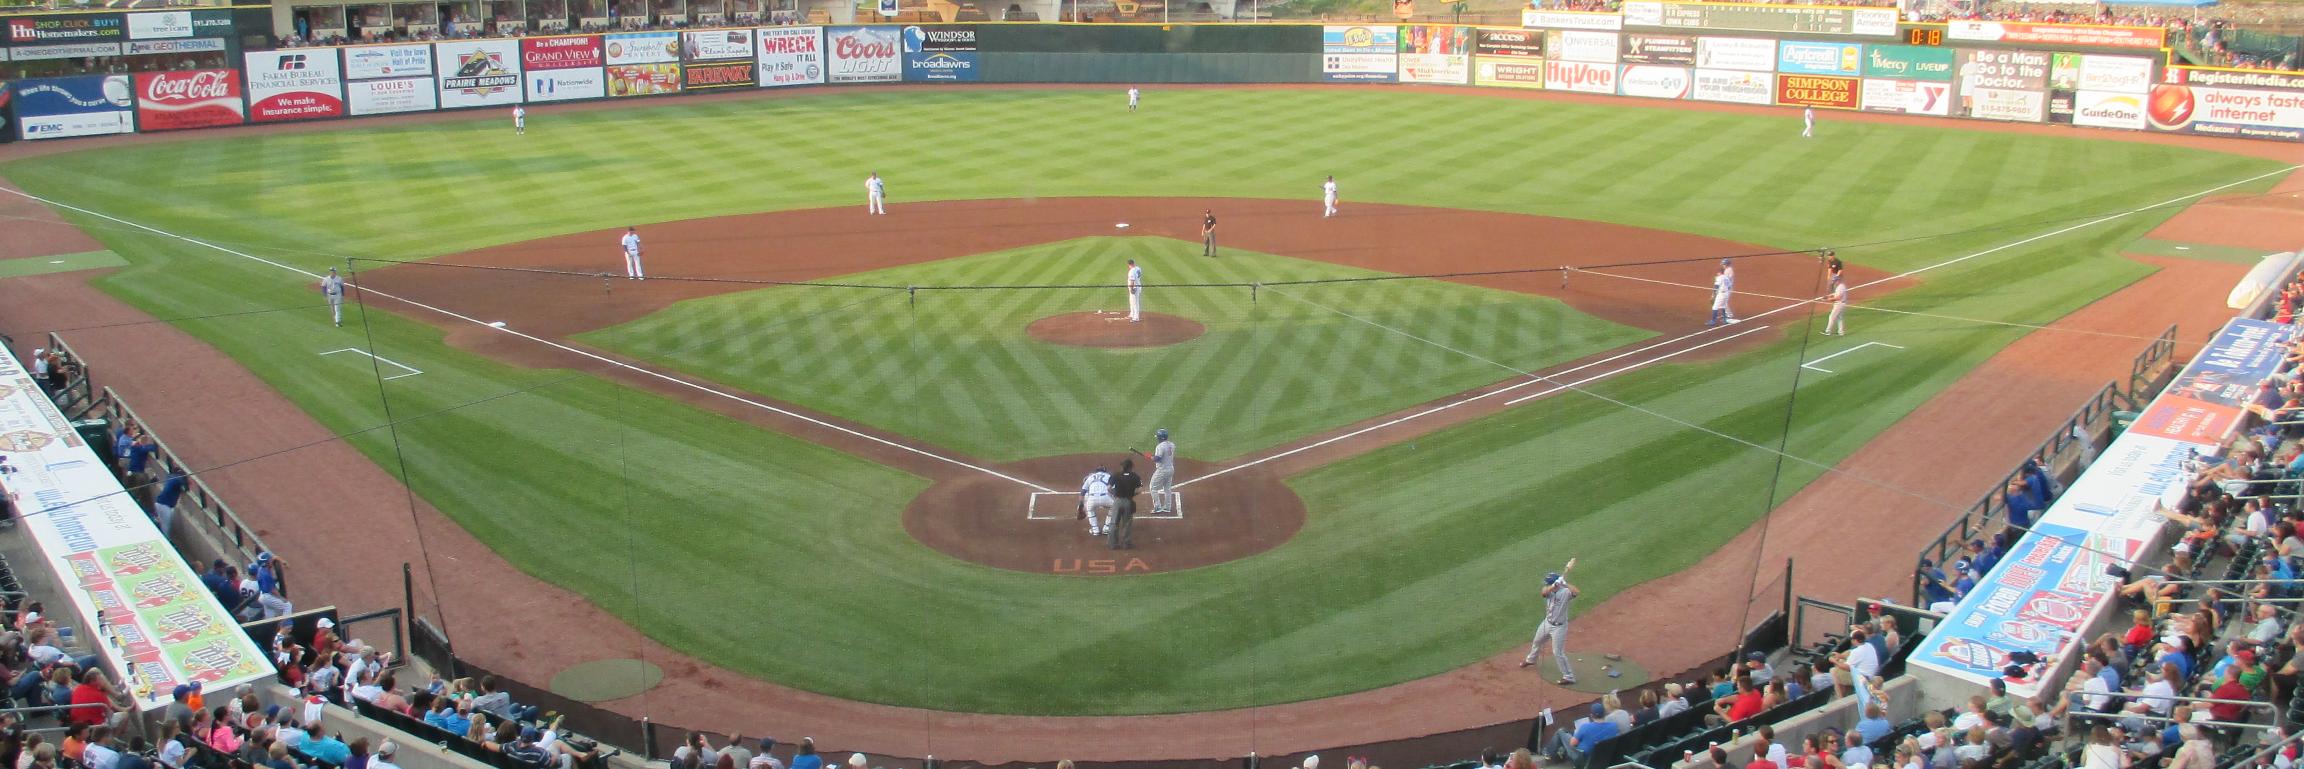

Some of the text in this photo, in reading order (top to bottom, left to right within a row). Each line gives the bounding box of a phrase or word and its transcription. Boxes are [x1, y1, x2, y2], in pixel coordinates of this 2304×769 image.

[549, 37, 589, 47] CHAMPION!
[927, 31, 975, 42] WINDSOR
[1911, 28, 1941, 46] 0:18
[154, 40, 217, 51] GEOTHERMAL
[764, 36, 816, 54] WRECK
[836, 36, 896, 59] Coors
[526, 49, 591, 62] GRAND VIEW
[797, 54, 816, 62] IT ALL
[1976, 50, 2048, 66] Be a Man.
[761, 63, 774, 72] Play
[780, 62, 793, 71] Safe
[839, 59, 893, 73] LIGHT
[912, 57, 971, 69] broadlawns
[1497, 66, 1537, 74] WRIGHT
[1876, 57, 1908, 74] Mercy
[1977, 63, 2043, 77] Go to the
[263, 70, 325, 80] FARM BUREAU
[445, 75, 517, 89] PRAIRIE MEADOWS
[687, 65, 752, 85] FAREWAY
[1975, 75, 2025, 89] Doctor.
[250, 78, 338, 90] FINANCIAL SERVICES
[371, 81, 414, 91] LOUIE'S
[557, 79, 593, 87] Nationwide
[1787, 77, 1849, 91] SIMPSON
[278, 96, 316, 106] We make
[1786, 88, 1849, 103] COLLEGE
[2204, 91, 2262, 107] always
[263, 105, 303, 116] insurance
[2081, 107, 2138, 121] GuideOne
[2210, 105, 2276, 122] internet
[40, 123, 63, 132] EMC
[1053, 557, 1150, 573] USA
